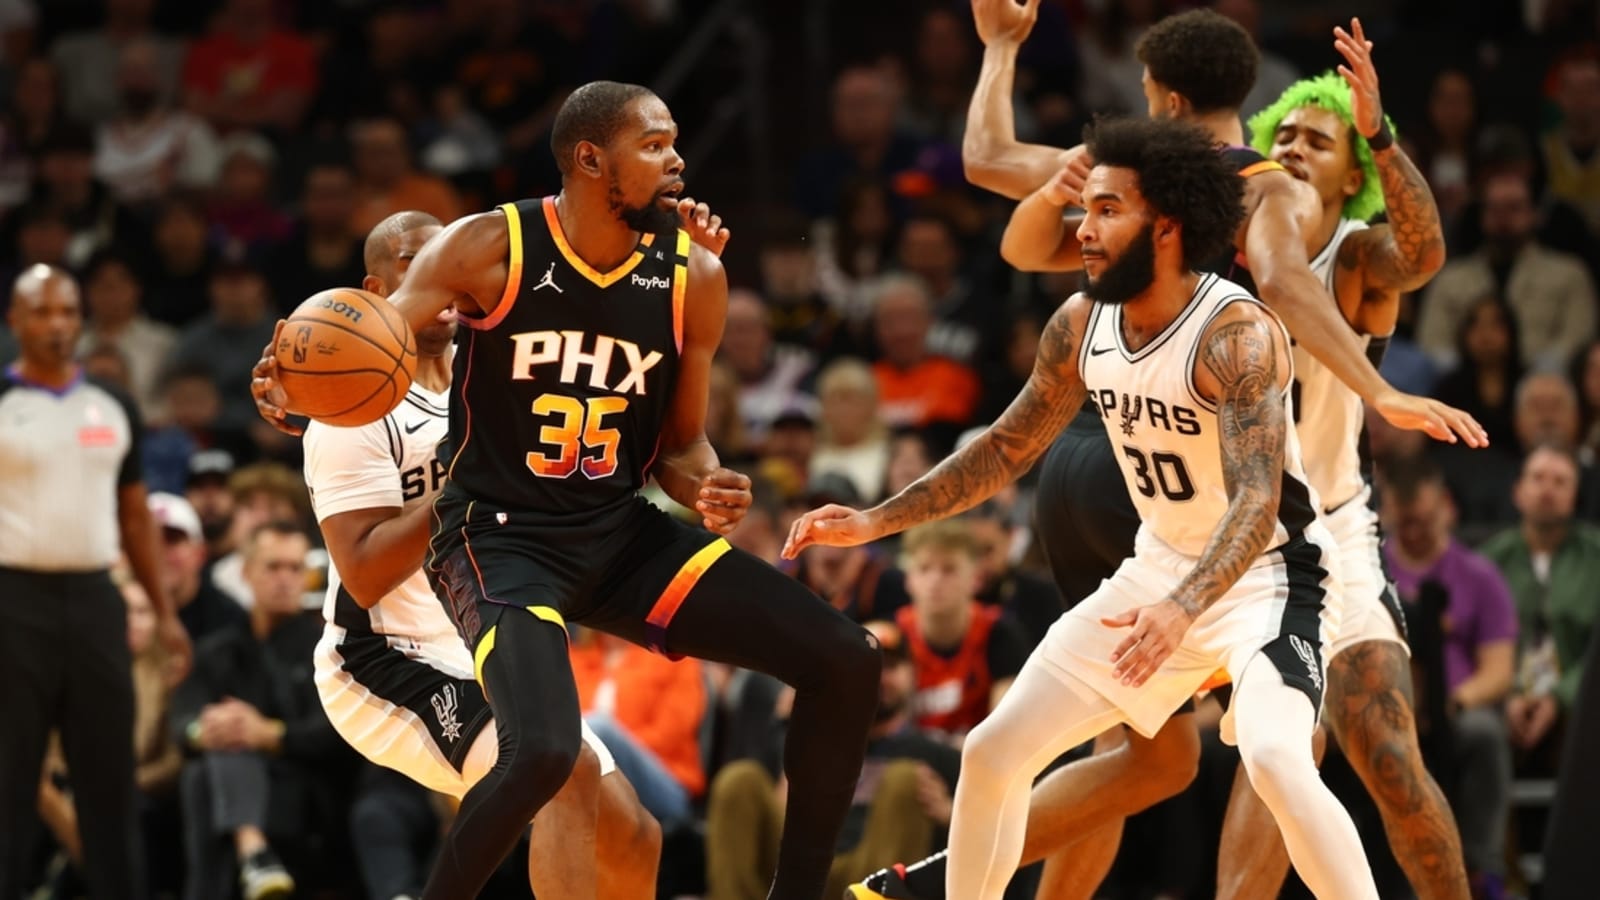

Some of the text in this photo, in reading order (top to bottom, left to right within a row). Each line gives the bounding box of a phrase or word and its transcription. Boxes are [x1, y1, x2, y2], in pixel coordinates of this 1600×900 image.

[632, 273, 670, 290] PayPal
[510, 330, 663, 395] PHX
[526, 393, 629, 480] 35
[1122, 444, 1198, 503] 30
